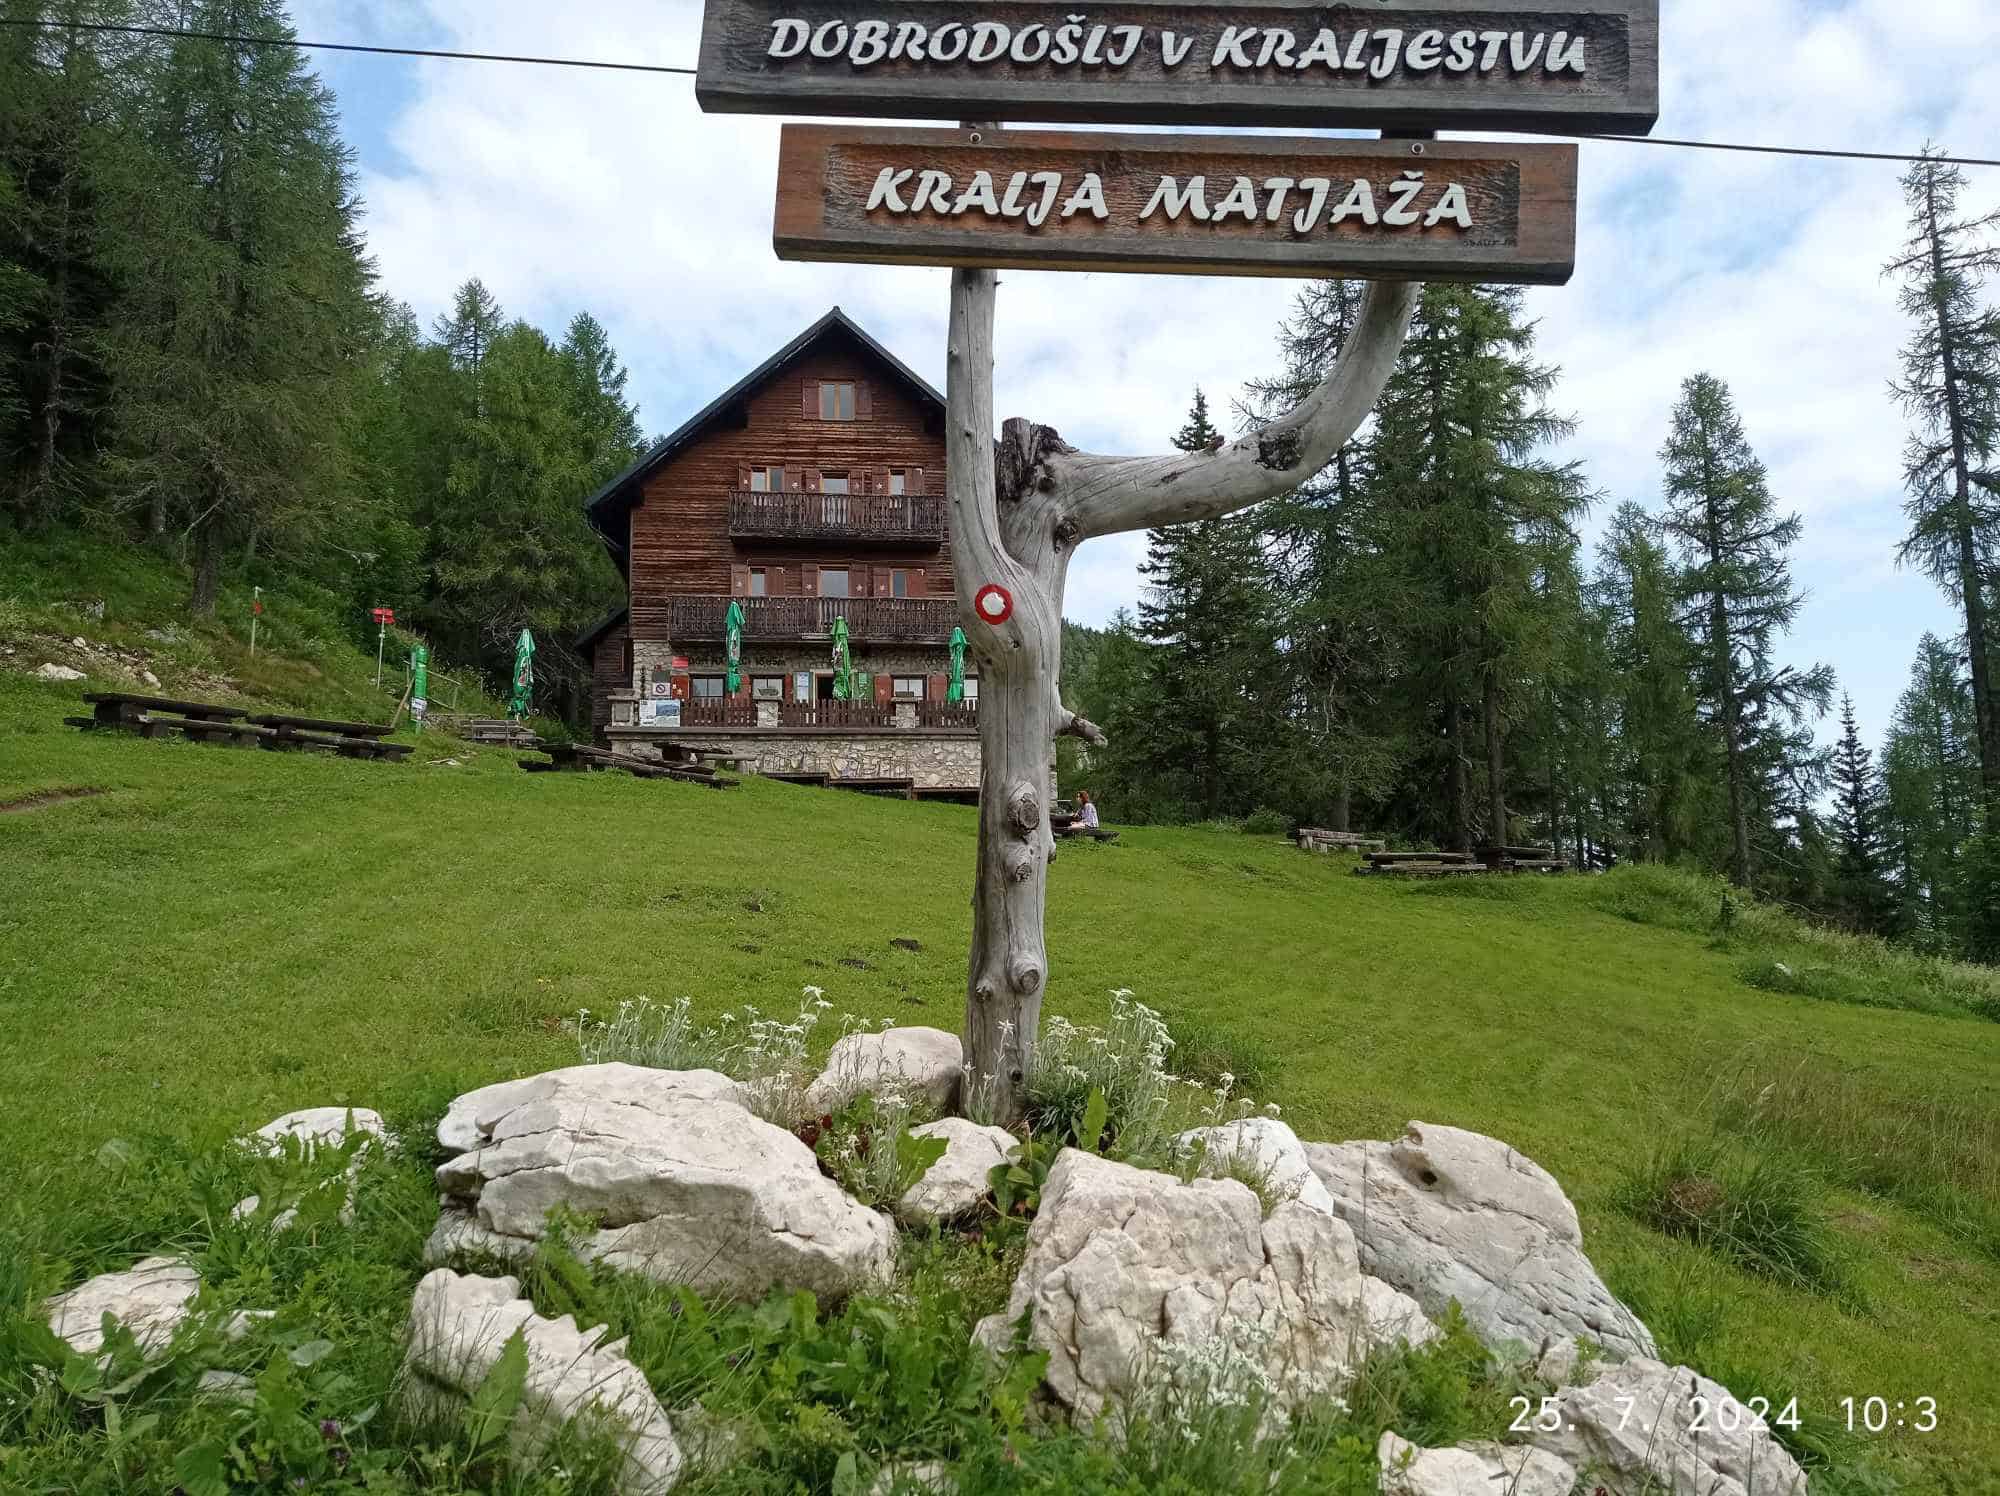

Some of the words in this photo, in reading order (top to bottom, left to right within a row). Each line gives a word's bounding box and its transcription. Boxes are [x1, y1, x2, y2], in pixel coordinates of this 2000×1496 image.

[767, 13, 1144, 66] DOBRODOŠLI
[1211, 25, 1586, 79] KRALJESTVU
[865, 166, 1110, 227] KRALJA
[1138, 170, 1473, 232] MATJAŽA
